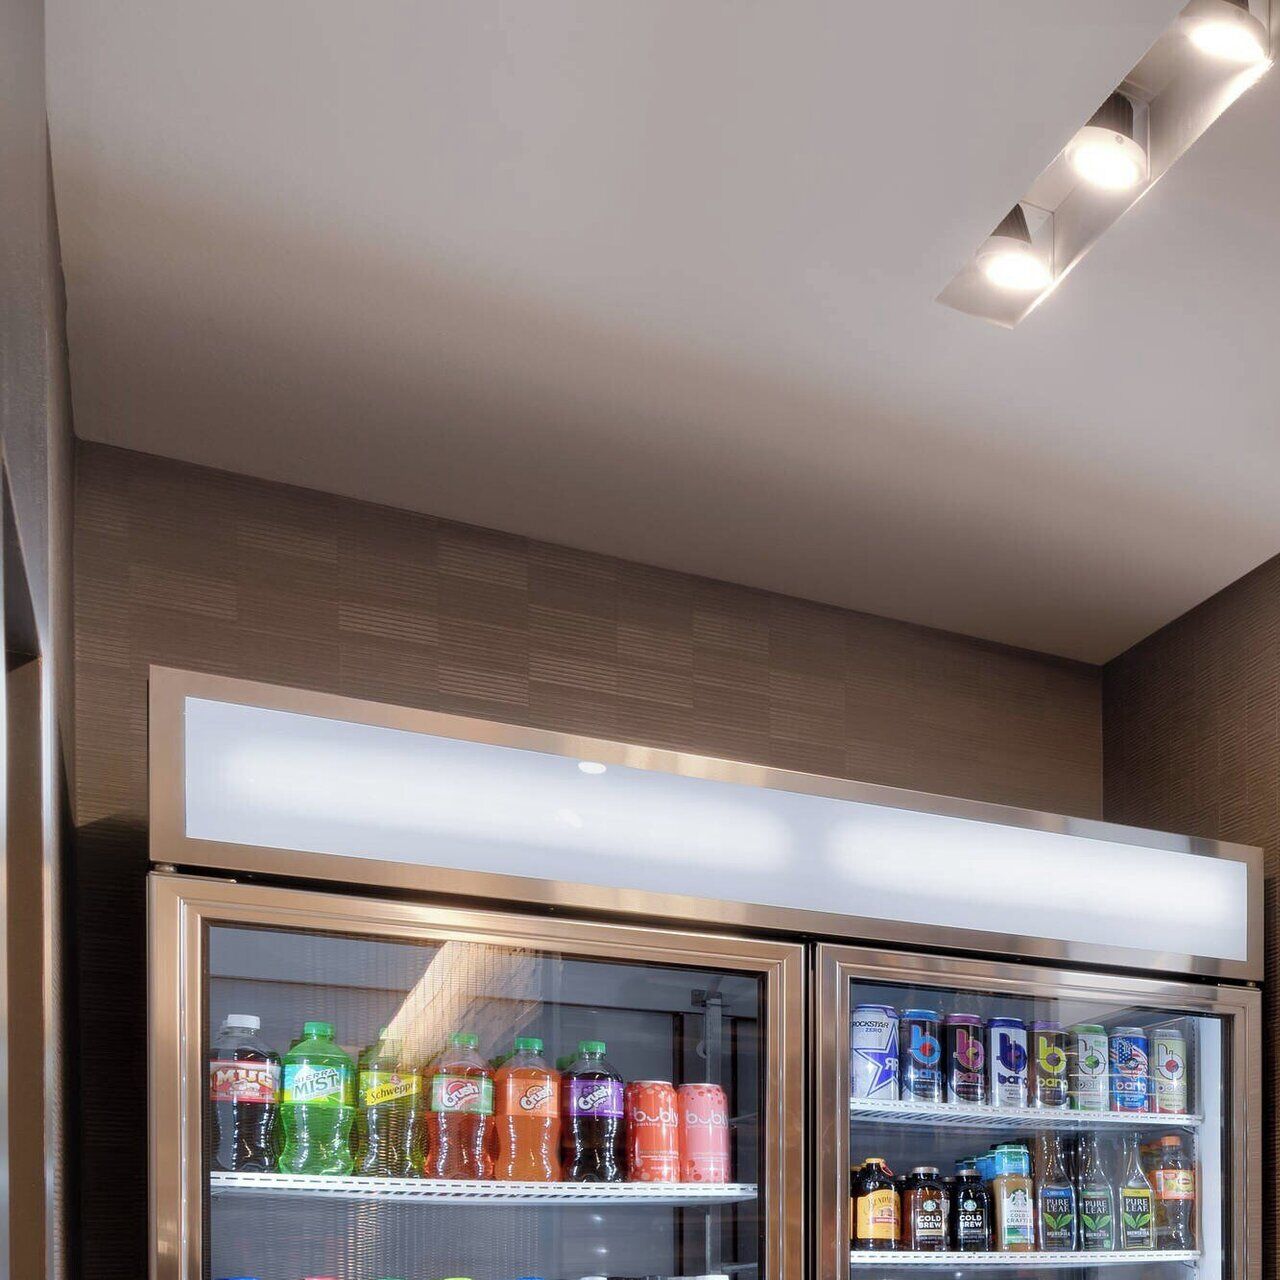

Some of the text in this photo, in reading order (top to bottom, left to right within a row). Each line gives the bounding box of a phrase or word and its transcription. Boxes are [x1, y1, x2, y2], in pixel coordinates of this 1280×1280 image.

[216, 1067, 274, 1087] MUG
[294, 1067, 337, 1085] SIERRA
[294, 1073, 339, 1097] MIST
[443, 1080, 481, 1108] Crush
[1116, 1081, 1147, 1094] bang
[519, 1085, 554, 1110] Crush
[578, 1086, 612, 1111] Crush
[634, 1107, 679, 1129] bubly
[686, 1109, 729, 1128] bubly
[1046, 1199, 1069, 1207] PURE
[1085, 1200, 1107, 1208] PURE
[1125, 1198, 1148, 1206] PURE
[918, 1221, 943, 1229] BREW
[959, 1213, 982, 1221] COLD
[959, 1220, 983, 1228] BREW
